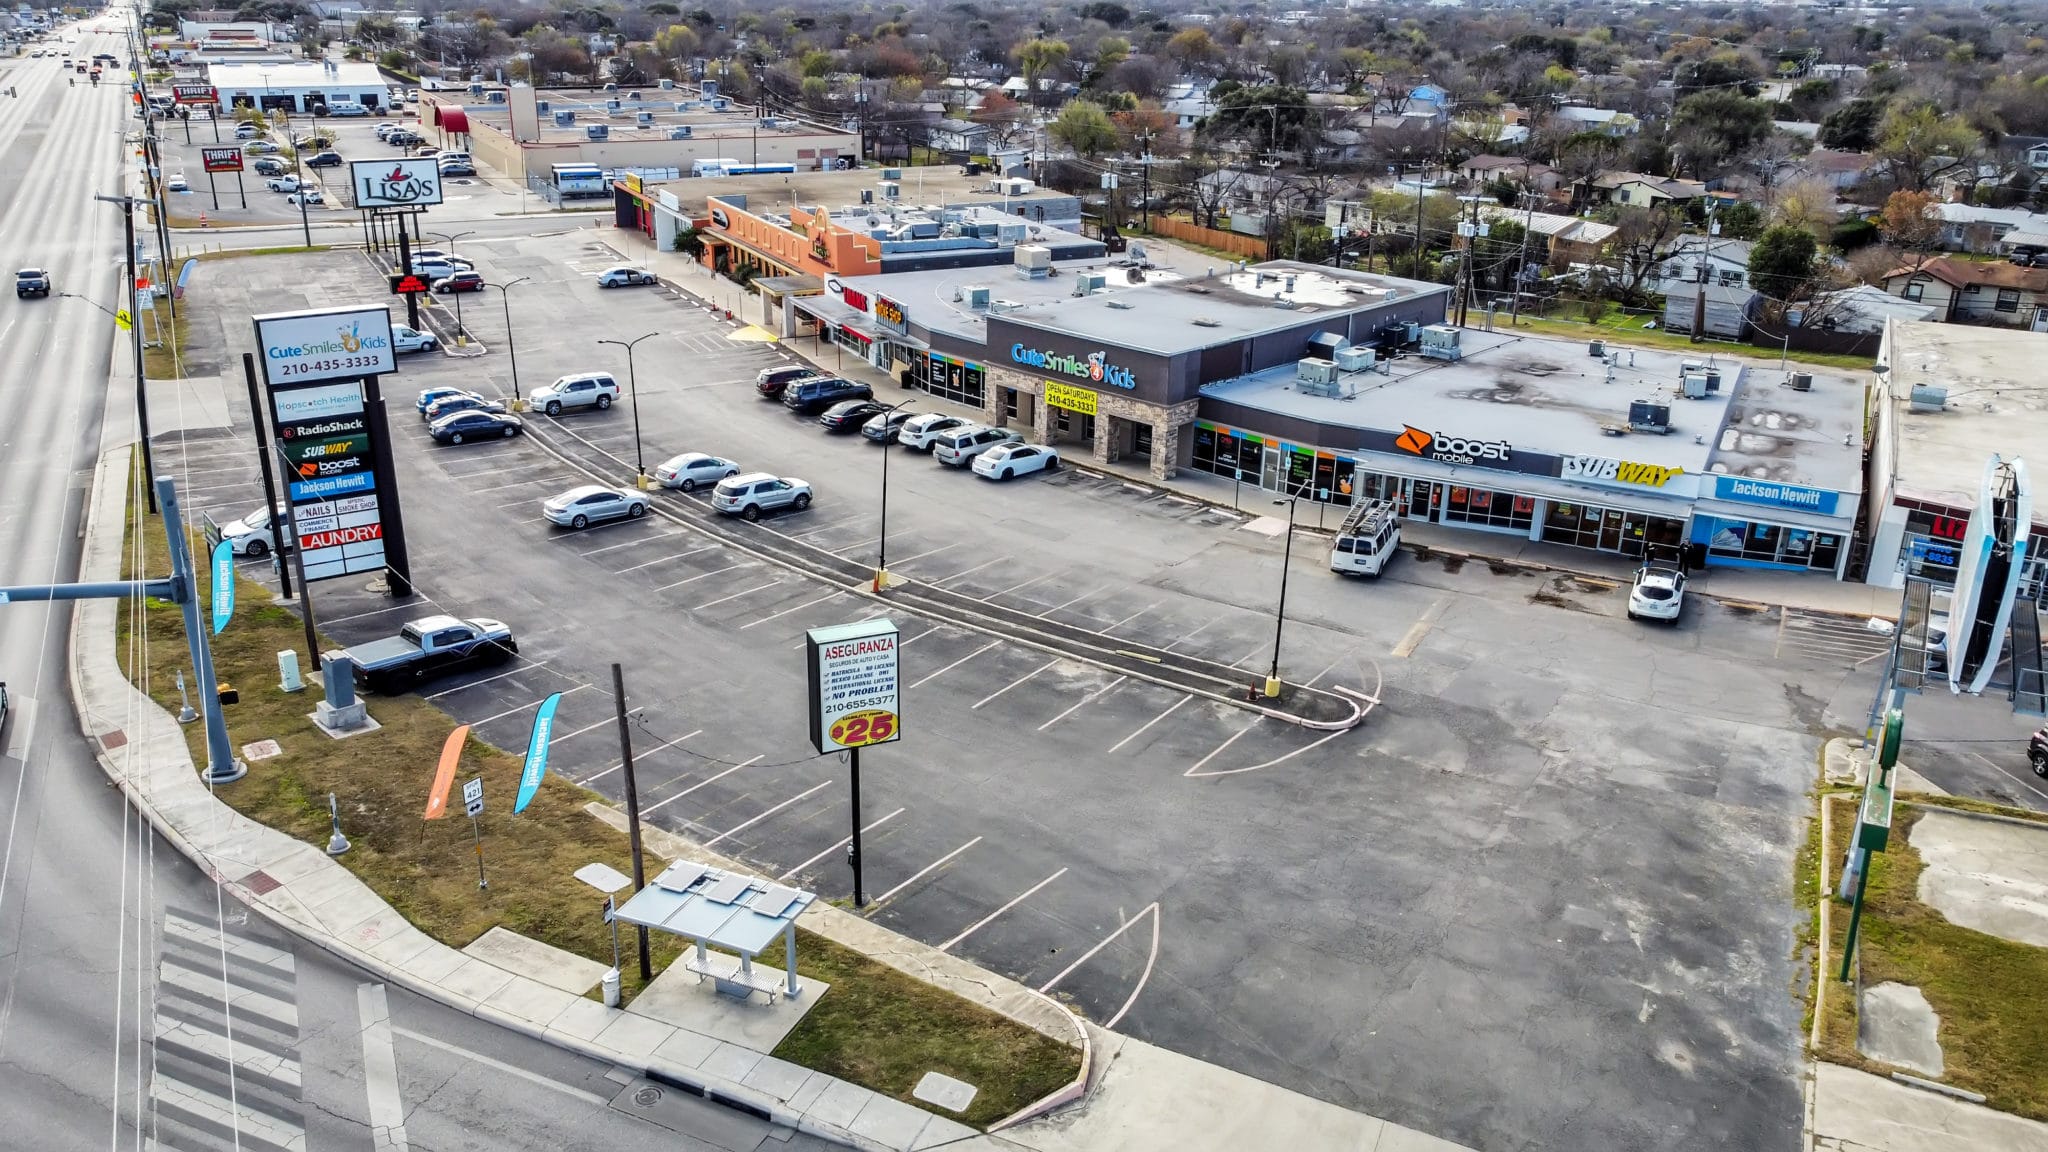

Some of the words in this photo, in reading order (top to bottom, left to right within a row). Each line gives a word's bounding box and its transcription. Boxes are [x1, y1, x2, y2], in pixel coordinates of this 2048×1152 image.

[176, 86, 214, 95] THRIFT
[203, 149, 240, 160] THRIFT
[360, 336, 387, 350] Kids
[282, 355, 380, 376] 210-435-3333
[1103, 364, 1136, 390] Kids
[329, 394, 361, 406] Health
[1046, 383, 1063, 396] OPEN
[1062, 387, 1096, 403] SATURDAYS
[1047, 394, 1095, 413] 210-435-3333
[296, 419, 364, 437] RadioShack
[301, 441, 353, 459] SUBWAY
[1434, 432, 1512, 461] boost
[318, 457, 361, 471] boost
[1432, 452, 1474, 465] mobile
[1565, 454, 1685, 488] SUBWAY
[299, 480, 336, 495] Jackson
[335, 475, 366, 489] Hewitt
[1731, 480, 1779, 499] Jackson
[1780, 486, 1821, 505] Hewitt
[305, 505, 331, 518] NAILS
[338, 504, 358, 513] SMOKE
[360, 501, 376, 509] SHOP
[299, 525, 380, 550] LAUNDRY
[824, 637, 894, 661] ASEGURANZA
[829, 659, 852, 669] SEGUROS
[860, 656, 872, 664] AUTO
[874, 661, 896, 670] LICENSE
[831, 680, 873, 691] INTERNATIONAL
[873, 676, 895, 685] LICENSE
[852, 672, 874, 681] LICENSE
[832, 691, 845, 700] NO
[848, 684, 894, 697] PROBLEM
[825, 695, 895, 714] 210-655-5377
[467, 787, 480, 799] 421
